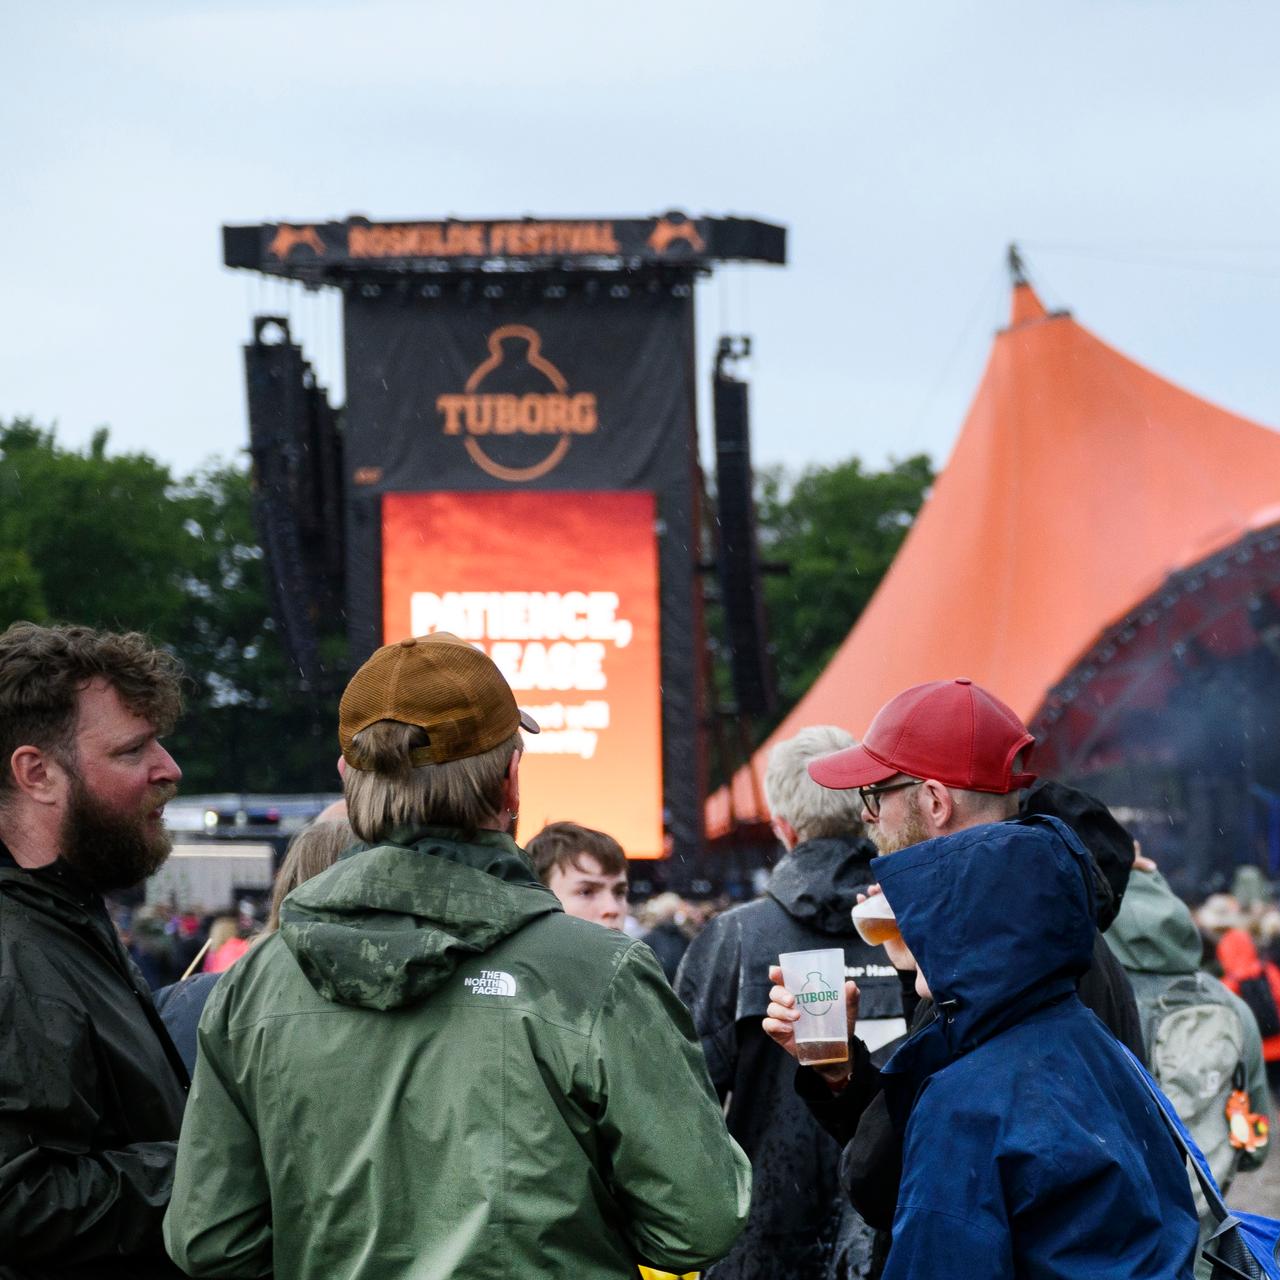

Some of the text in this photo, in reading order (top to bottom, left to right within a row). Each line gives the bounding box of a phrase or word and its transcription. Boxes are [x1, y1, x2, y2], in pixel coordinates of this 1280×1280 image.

[436, 392, 599, 436] TUBORG
[480, 970, 501, 980] THE
[464, 977, 500, 987] NORTH
[472, 986, 499, 995] FACE
[795, 990, 839, 1005] TUBORG
